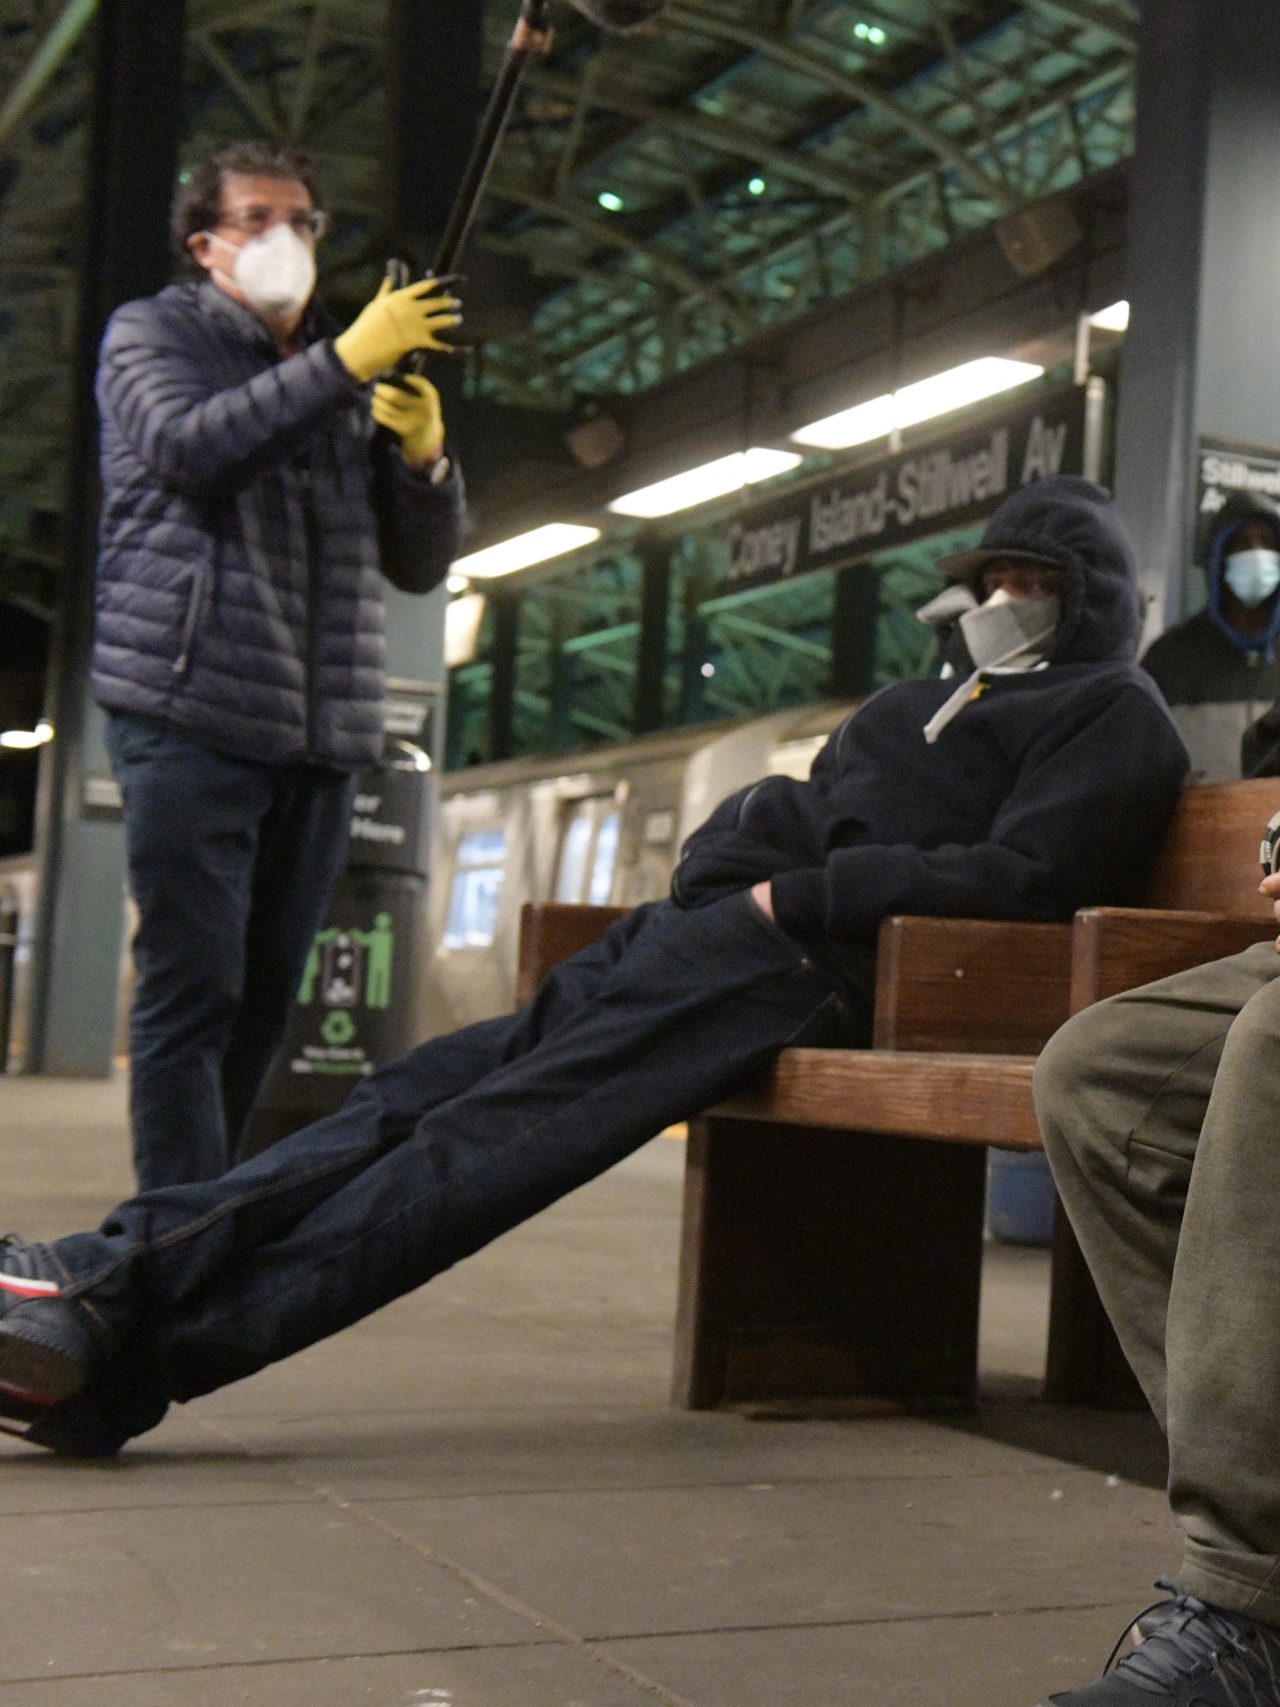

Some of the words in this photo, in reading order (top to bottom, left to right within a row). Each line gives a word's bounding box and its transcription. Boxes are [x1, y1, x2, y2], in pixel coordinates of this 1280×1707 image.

[728, 516, 802, 580] Coney
[809, 427, 1009, 551] Island-Stillwell
[1021, 415, 1067, 485] Av
